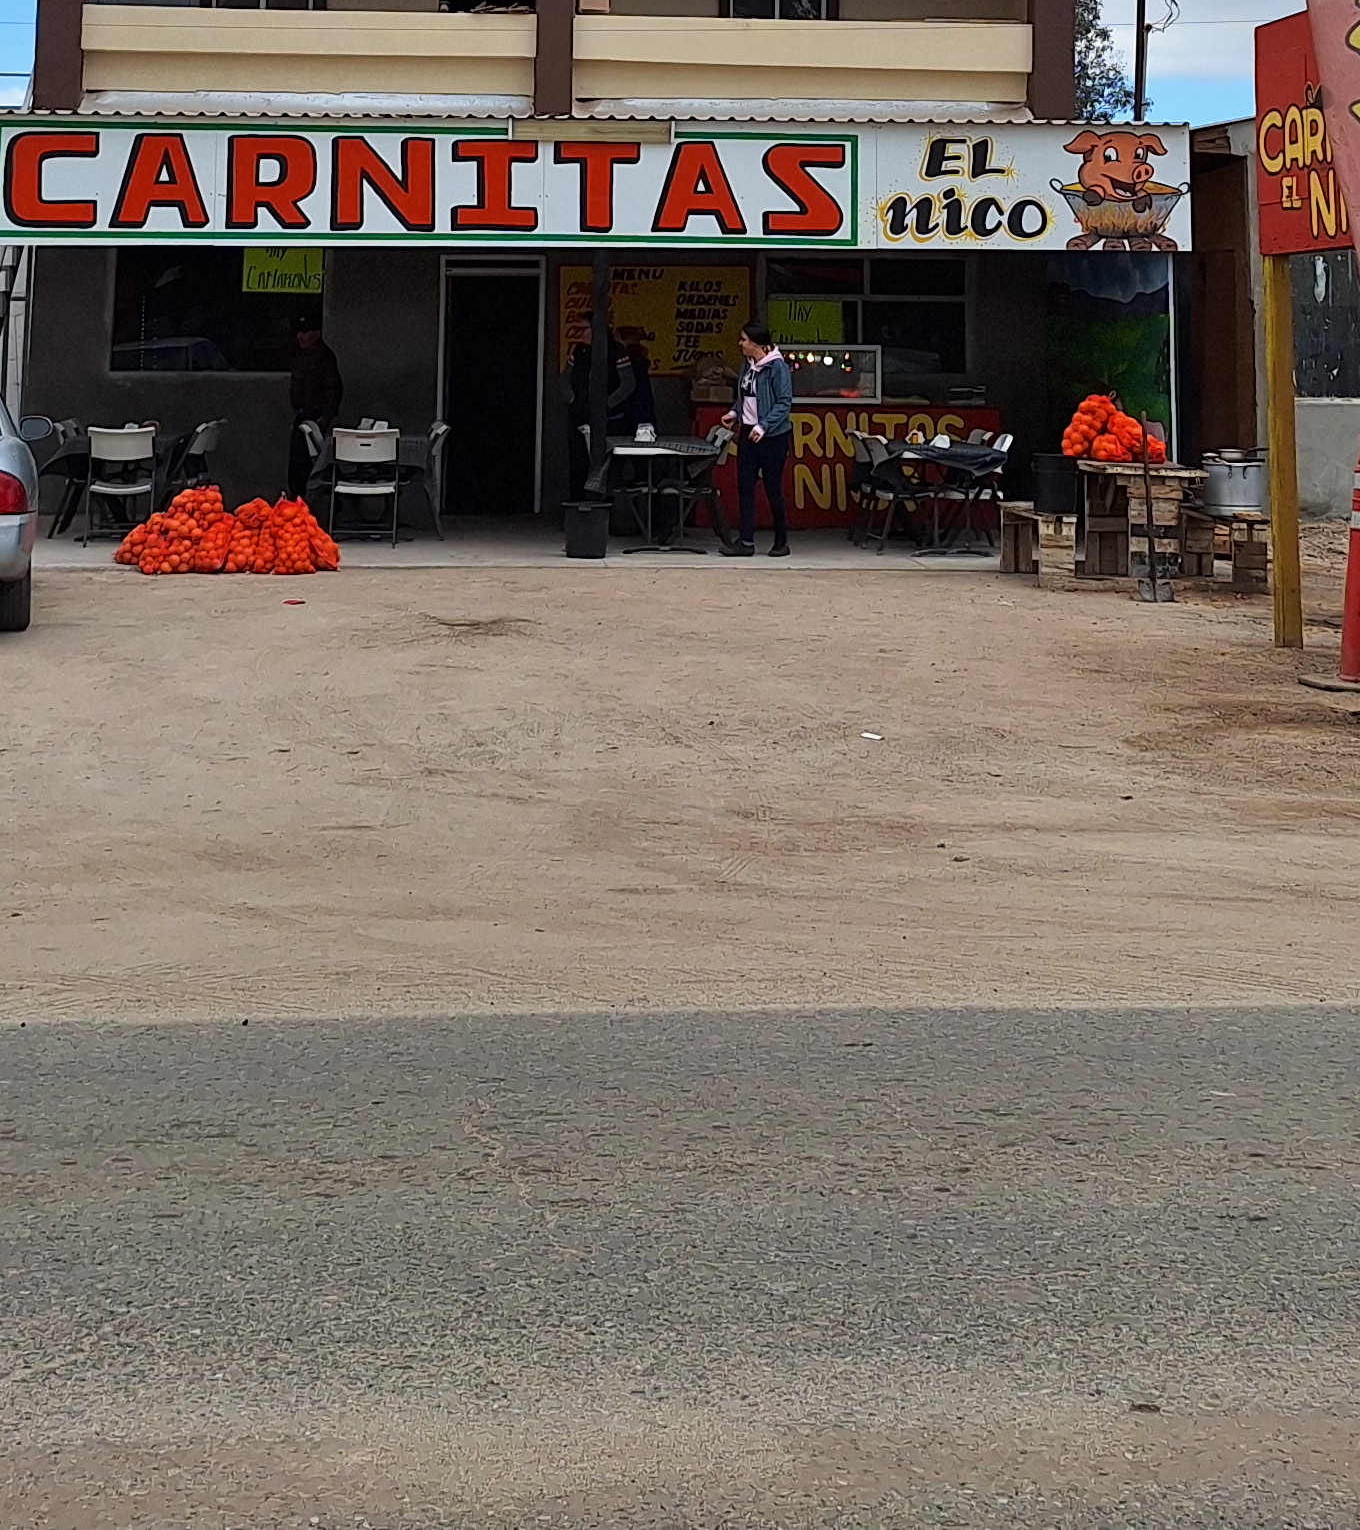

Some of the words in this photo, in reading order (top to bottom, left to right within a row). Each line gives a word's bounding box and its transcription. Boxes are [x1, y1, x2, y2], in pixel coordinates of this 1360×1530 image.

[1259, 104, 1334, 176] CAR
[923, 136, 1008, 180] EL
[4, 130, 846, 235] CARNITAS
[1281, 175, 1303, 210] EL
[884, 187, 1049, 239] nico
[611, 268, 665, 281] MENU
[678, 281, 722, 293] KILOS
[676, 294, 739, 306] ORDENES
[675, 308, 728, 320] MEDIAS
[676, 322, 723, 334] SODAS
[676, 335, 700, 348] TEE
